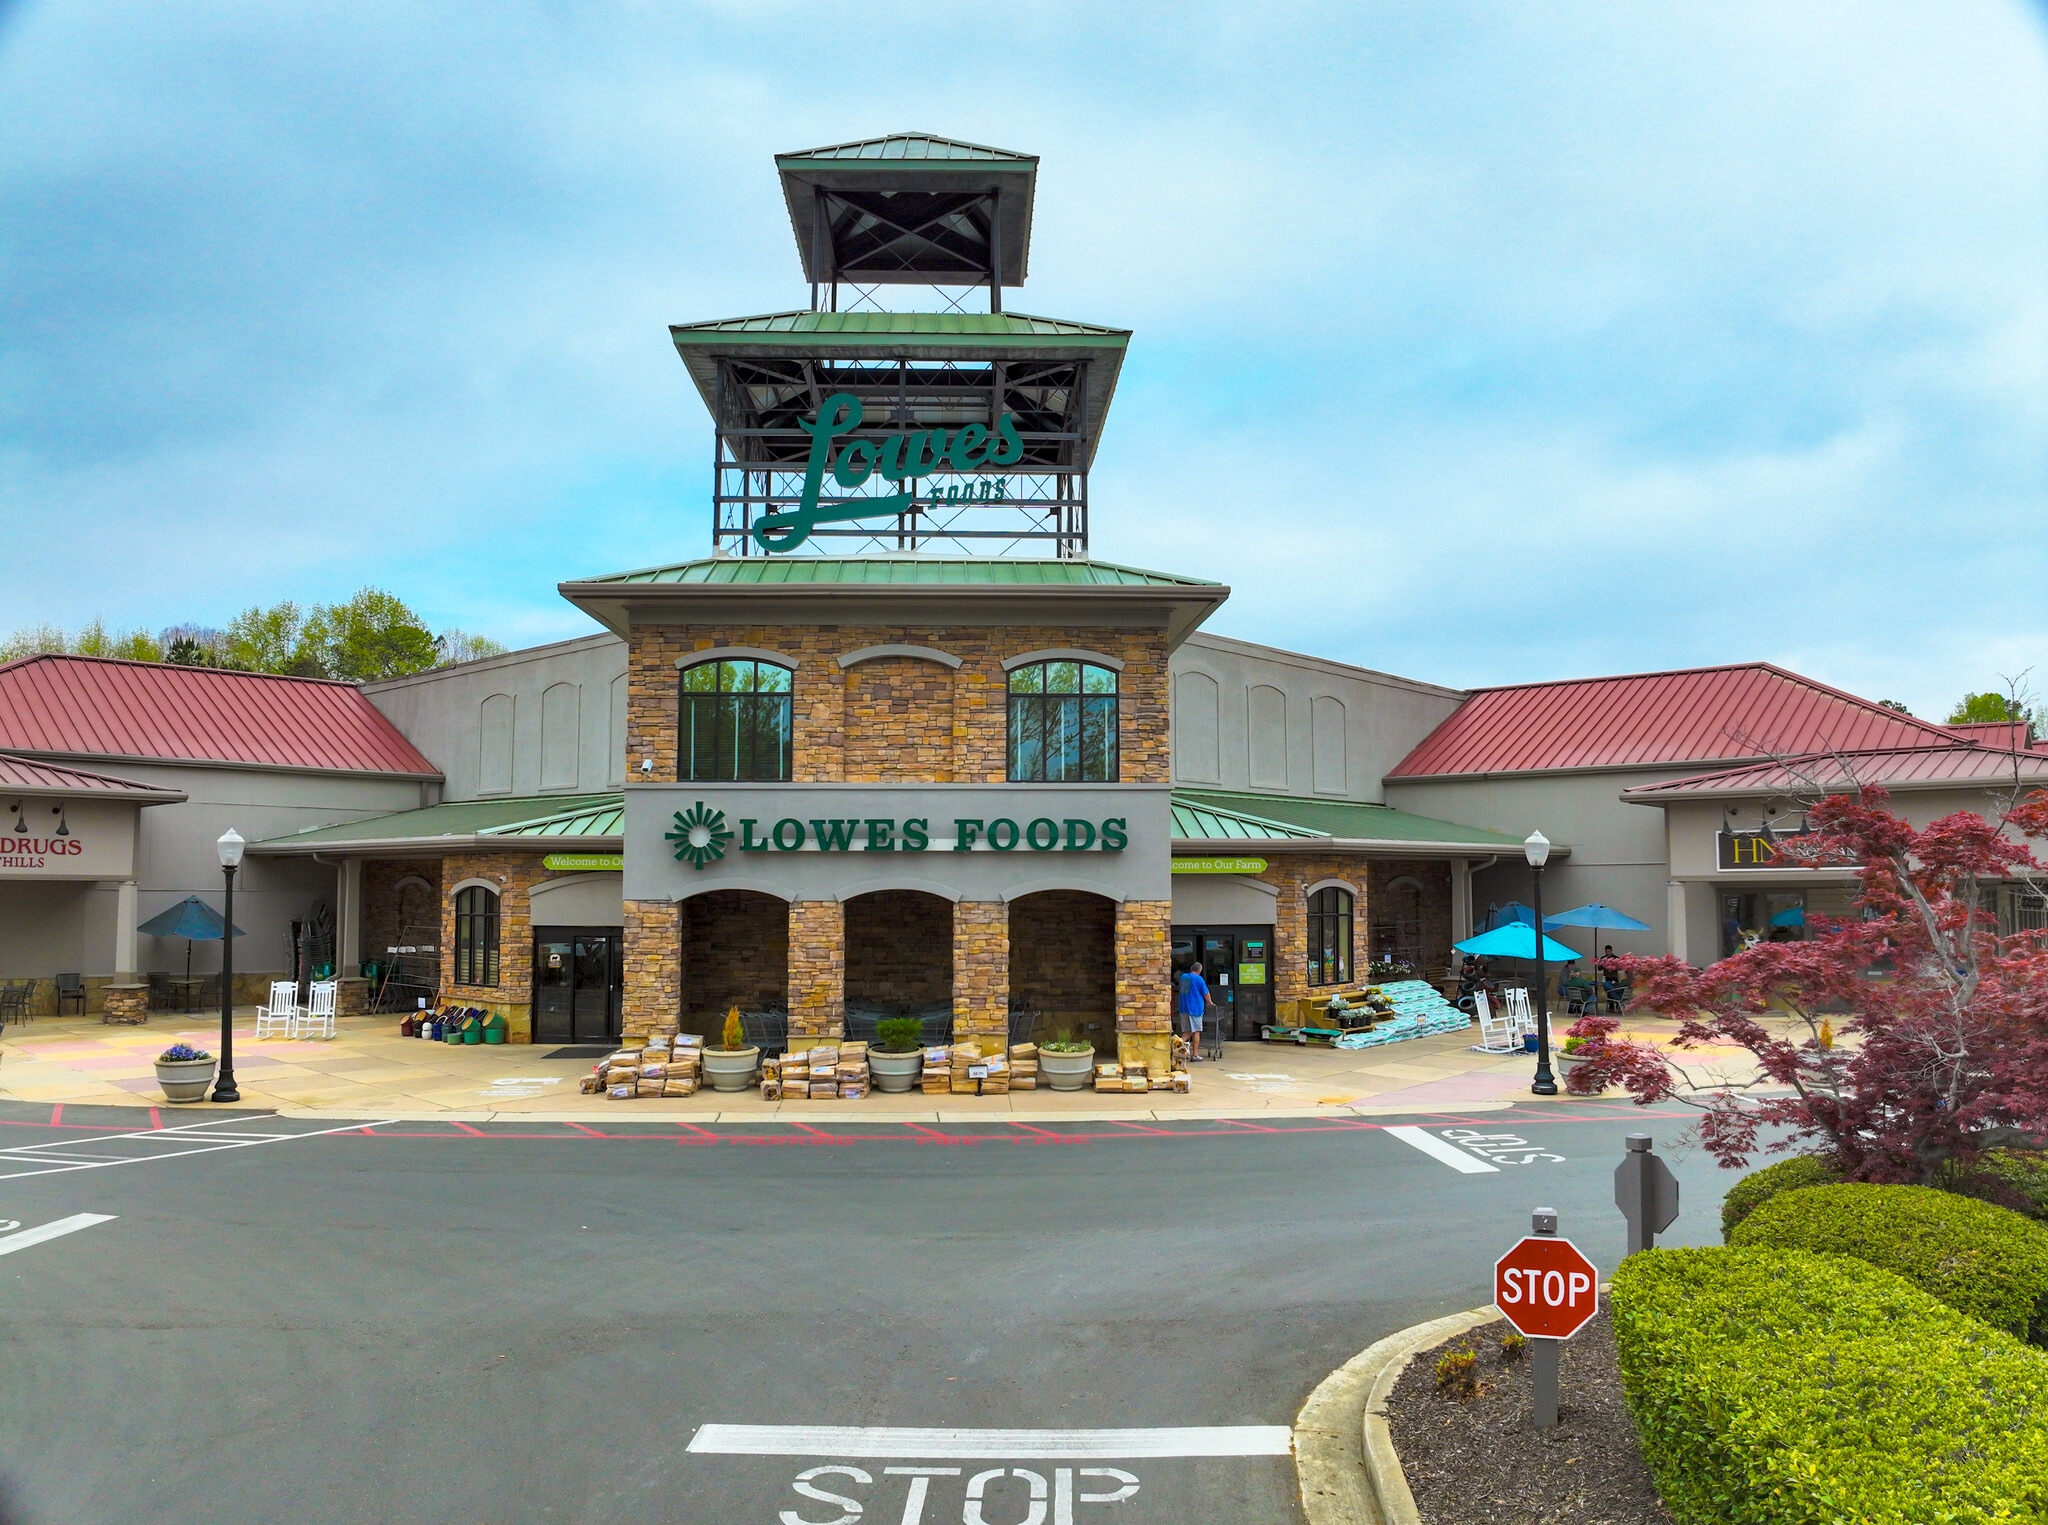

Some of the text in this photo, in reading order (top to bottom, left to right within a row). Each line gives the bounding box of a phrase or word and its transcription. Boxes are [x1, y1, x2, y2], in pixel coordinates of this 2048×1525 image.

[753, 393, 1024, 552] Lowes
[927, 478, 1006, 510] FOODS
[0, 837, 82, 855] DRUGS
[739, 817, 1129, 852] LOWES FOODS
[0, 857, 45, 868] HILLS
[551, 856, 597, 866] Welcome
[600, 858, 610, 866] to
[1170, 860, 1261, 869] come to Our Farm
[1501, 1267, 1590, 1308] STOP
[779, 1465, 1140, 1525] STOP
